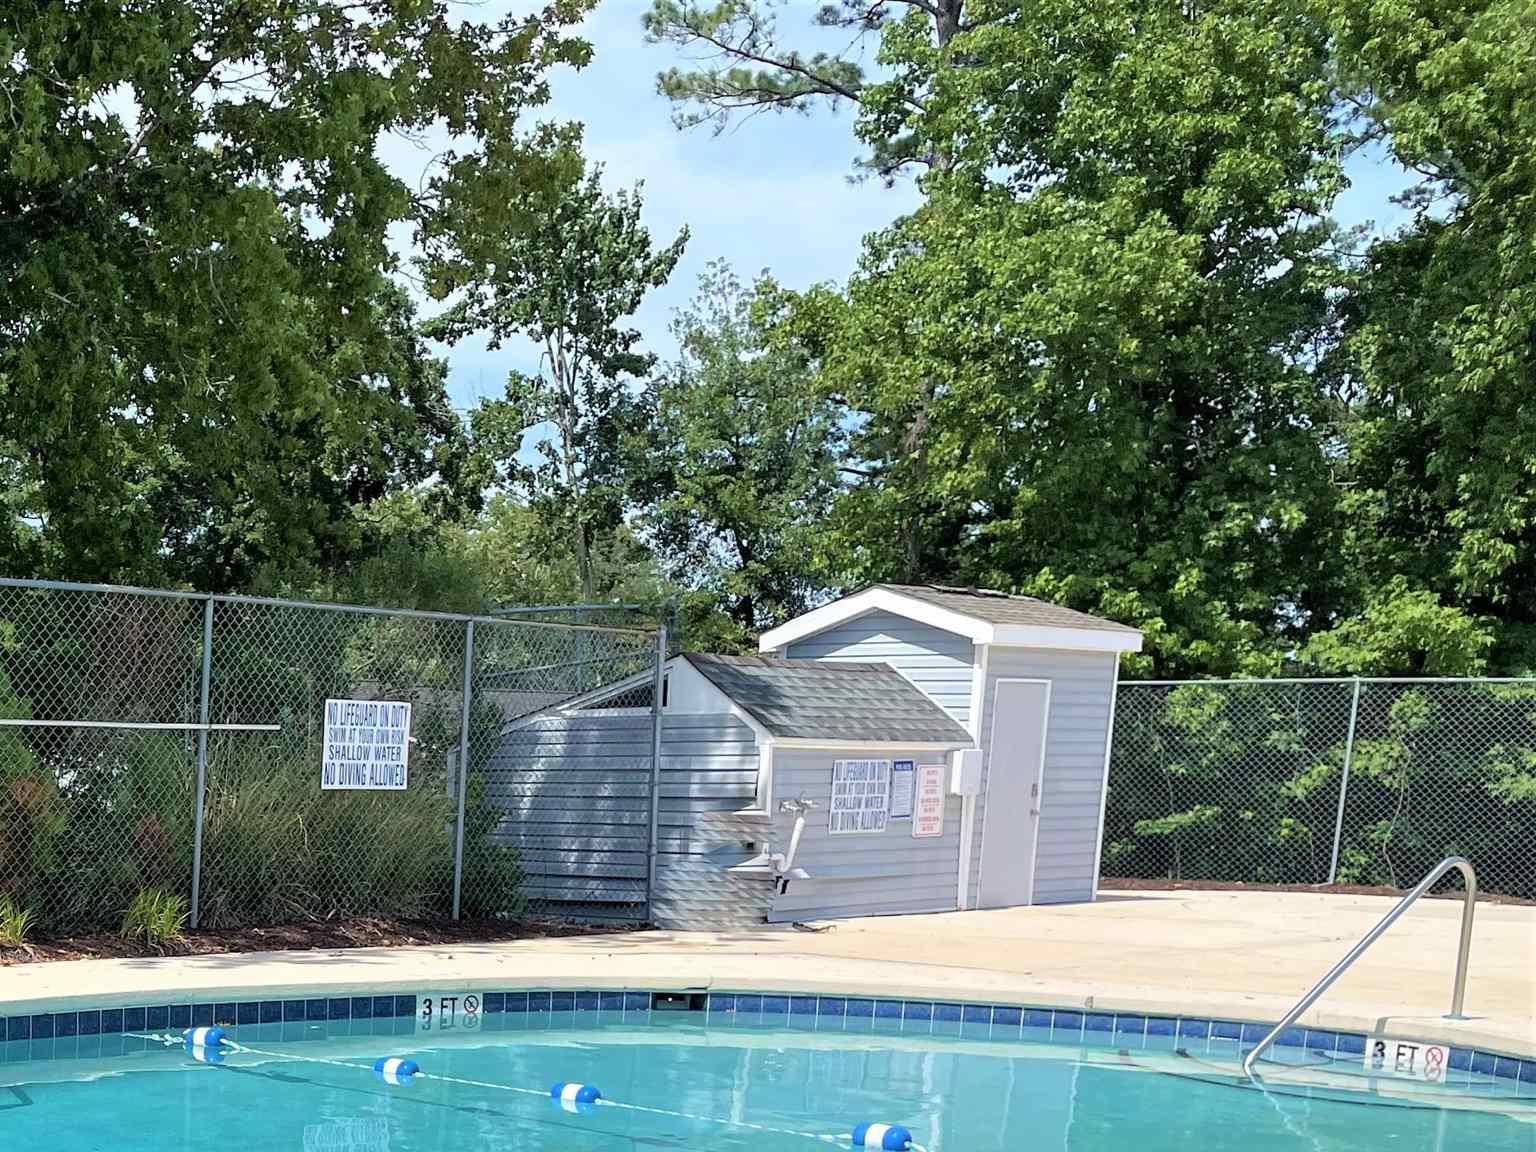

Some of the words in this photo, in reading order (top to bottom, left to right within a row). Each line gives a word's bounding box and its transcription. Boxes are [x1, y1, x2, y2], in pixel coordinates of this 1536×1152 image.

[328, 702, 338, 725] NO
[340, 703, 378, 727] LIFEGUARD
[380, 704, 390, 727] ON
[391, 705, 409, 728] DUTY
[328, 727, 346, 743] SWIM
[348, 728, 356, 743] AT
[376, 729, 389, 744] OWN
[328, 744, 371, 761] SHALLOW
[374, 746, 401, 761] WATER
[324, 763, 336, 785] NO
[339, 763, 367, 786] DIVING
[369, 764, 405, 787] ALLOWED
[423, 998, 433, 1016] 3
[441, 997, 458, 1017] FT
[1372, 1041, 1386, 1058] 3
[1395, 1044, 1420, 1063] FT
